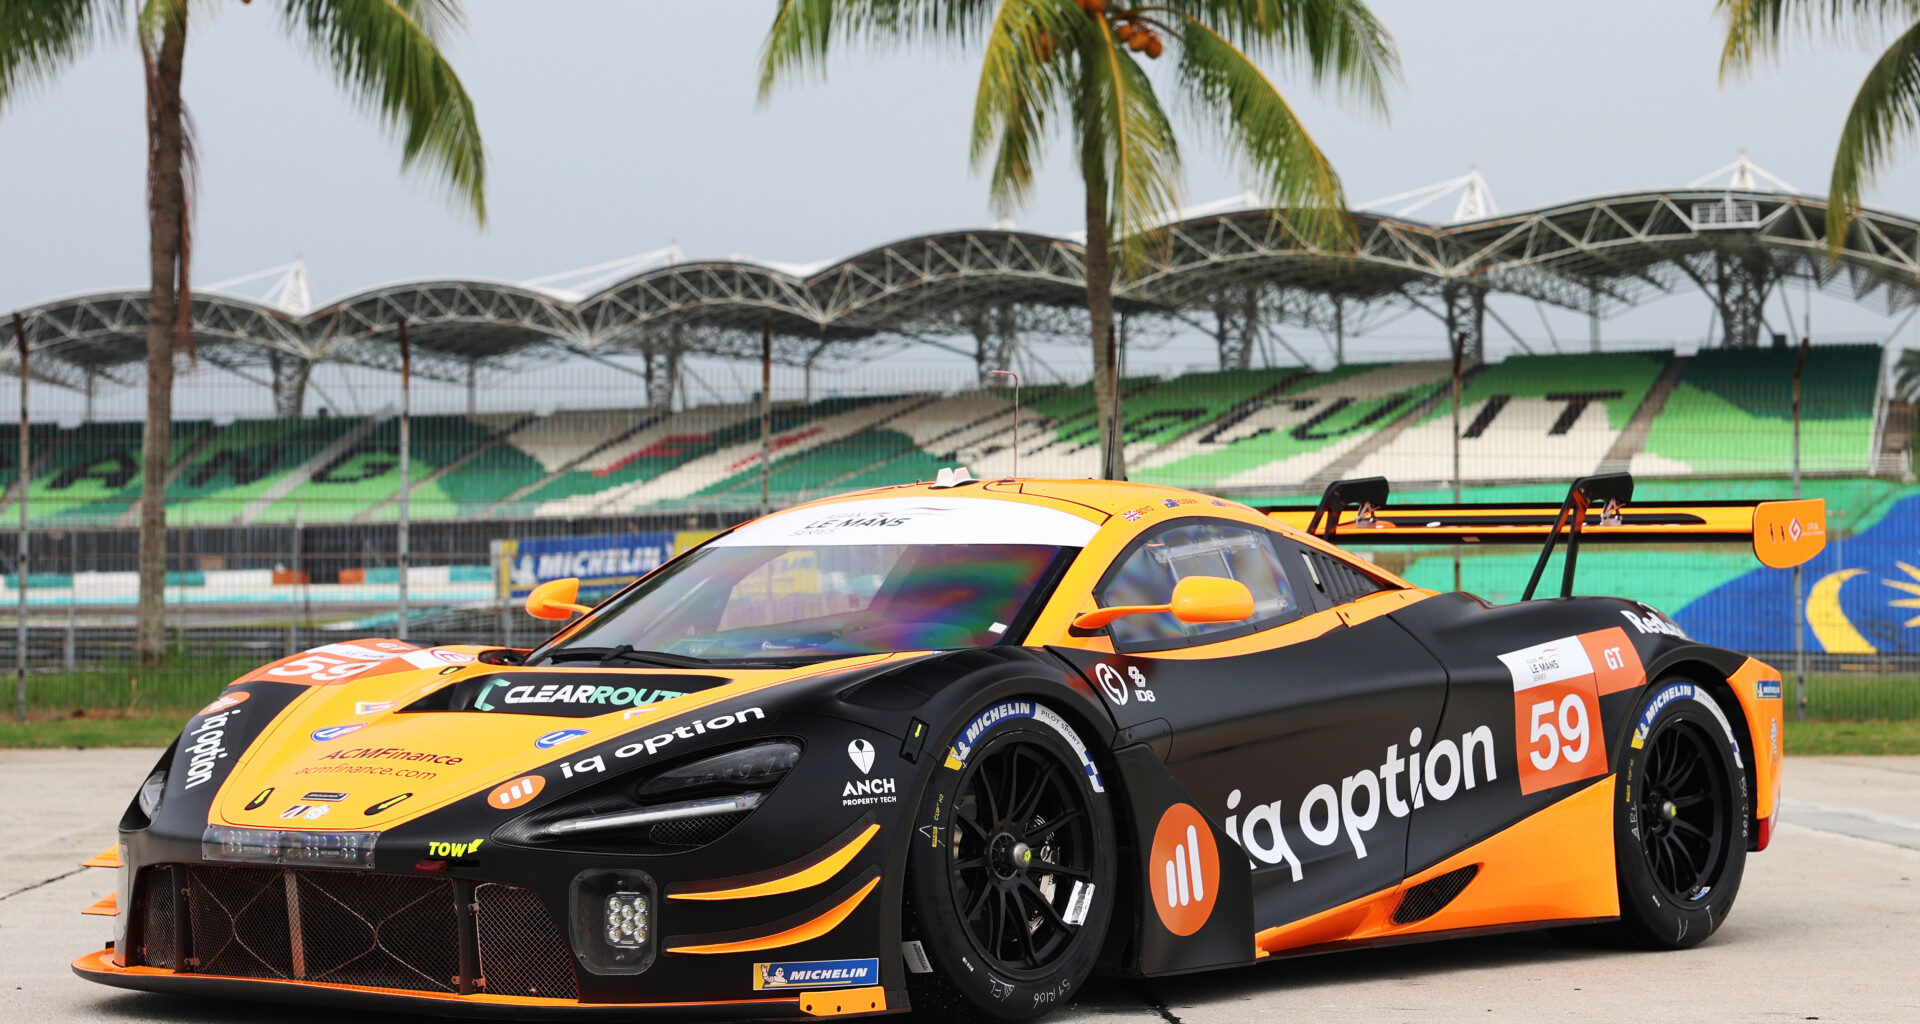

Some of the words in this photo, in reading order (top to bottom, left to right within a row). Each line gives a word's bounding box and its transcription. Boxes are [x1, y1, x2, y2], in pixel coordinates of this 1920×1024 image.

[804, 520, 840, 529] LE
[836, 518, 911, 528] MANS
[536, 547, 662, 578] MICHELIN
[268, 656, 381, 680] 59
[1530, 664, 1540, 674] LE
[1539, 659, 1560, 671] MANS
[1603, 647, 1624, 670] GT
[504, 684, 691, 707] CLEARROUT
[1645, 684, 1693, 722] MICHELIN
[191, 709, 242, 736] iq
[965, 702, 1030, 743] MICHELIN
[1041, 709, 1060, 724] PILOT
[1060, 723, 1081, 746] SPORT
[1529, 693, 1590, 771] 59
[560, 754, 606, 779] iq
[614, 707, 765, 758] option
[185, 729, 228, 790] option
[319, 747, 463, 767] ACMFinance
[295, 762, 437, 781] acmfinance.com
[842, 778, 896, 796] ANCH
[842, 797, 879, 806] PROPERTY
[1225, 789, 1304, 882] iq
[1299, 725, 1497, 859] option
[428, 842, 467, 858] TOW
[789, 967, 869, 981] MICHELIN
